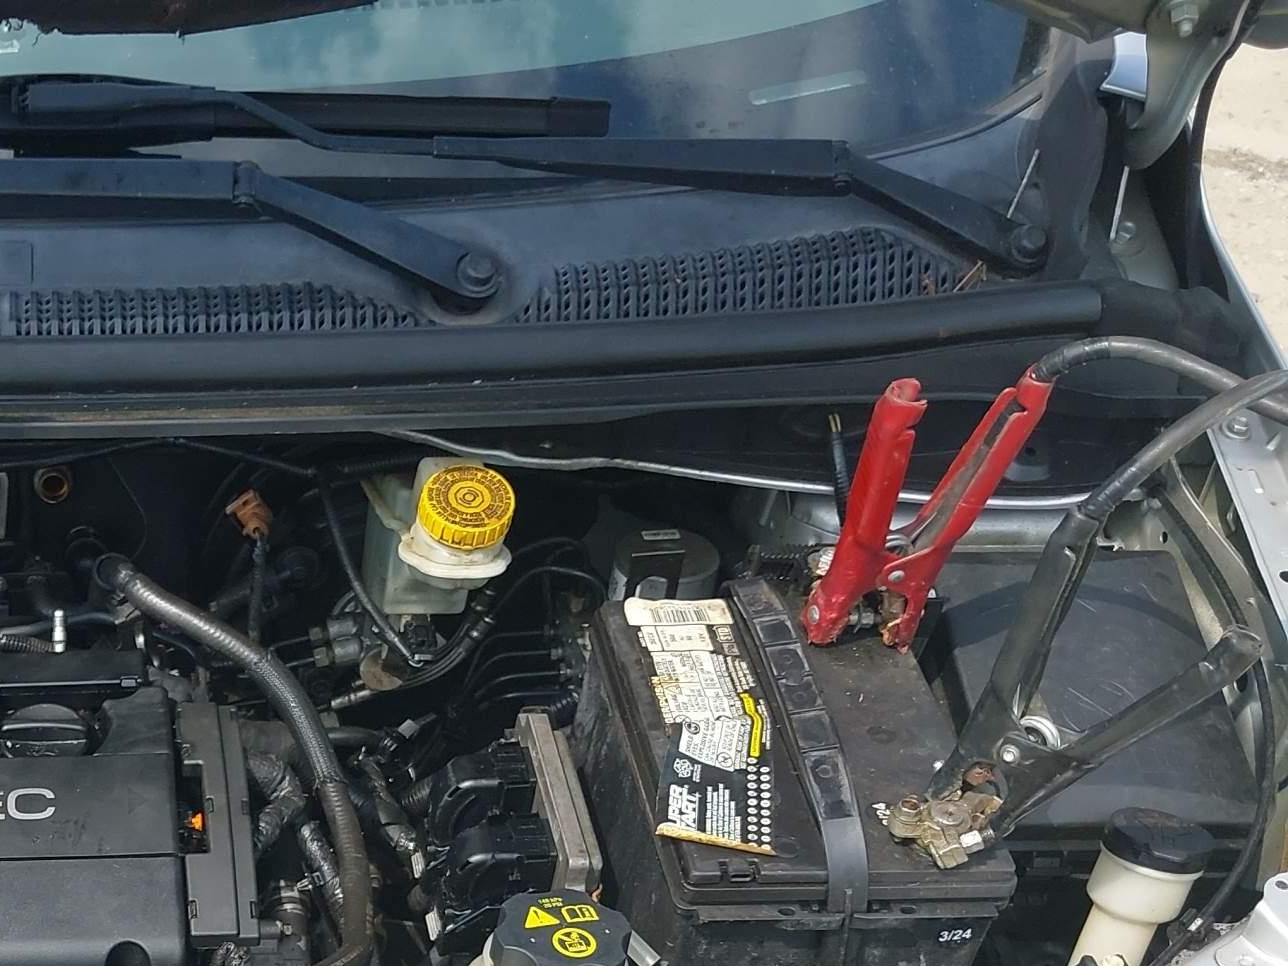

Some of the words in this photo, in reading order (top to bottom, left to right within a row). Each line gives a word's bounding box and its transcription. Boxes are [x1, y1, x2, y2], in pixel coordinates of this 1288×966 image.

[667, 784, 685, 826] UPER
[679, 787, 698, 830] TART
[938, 928, 972, 942] 3/24
